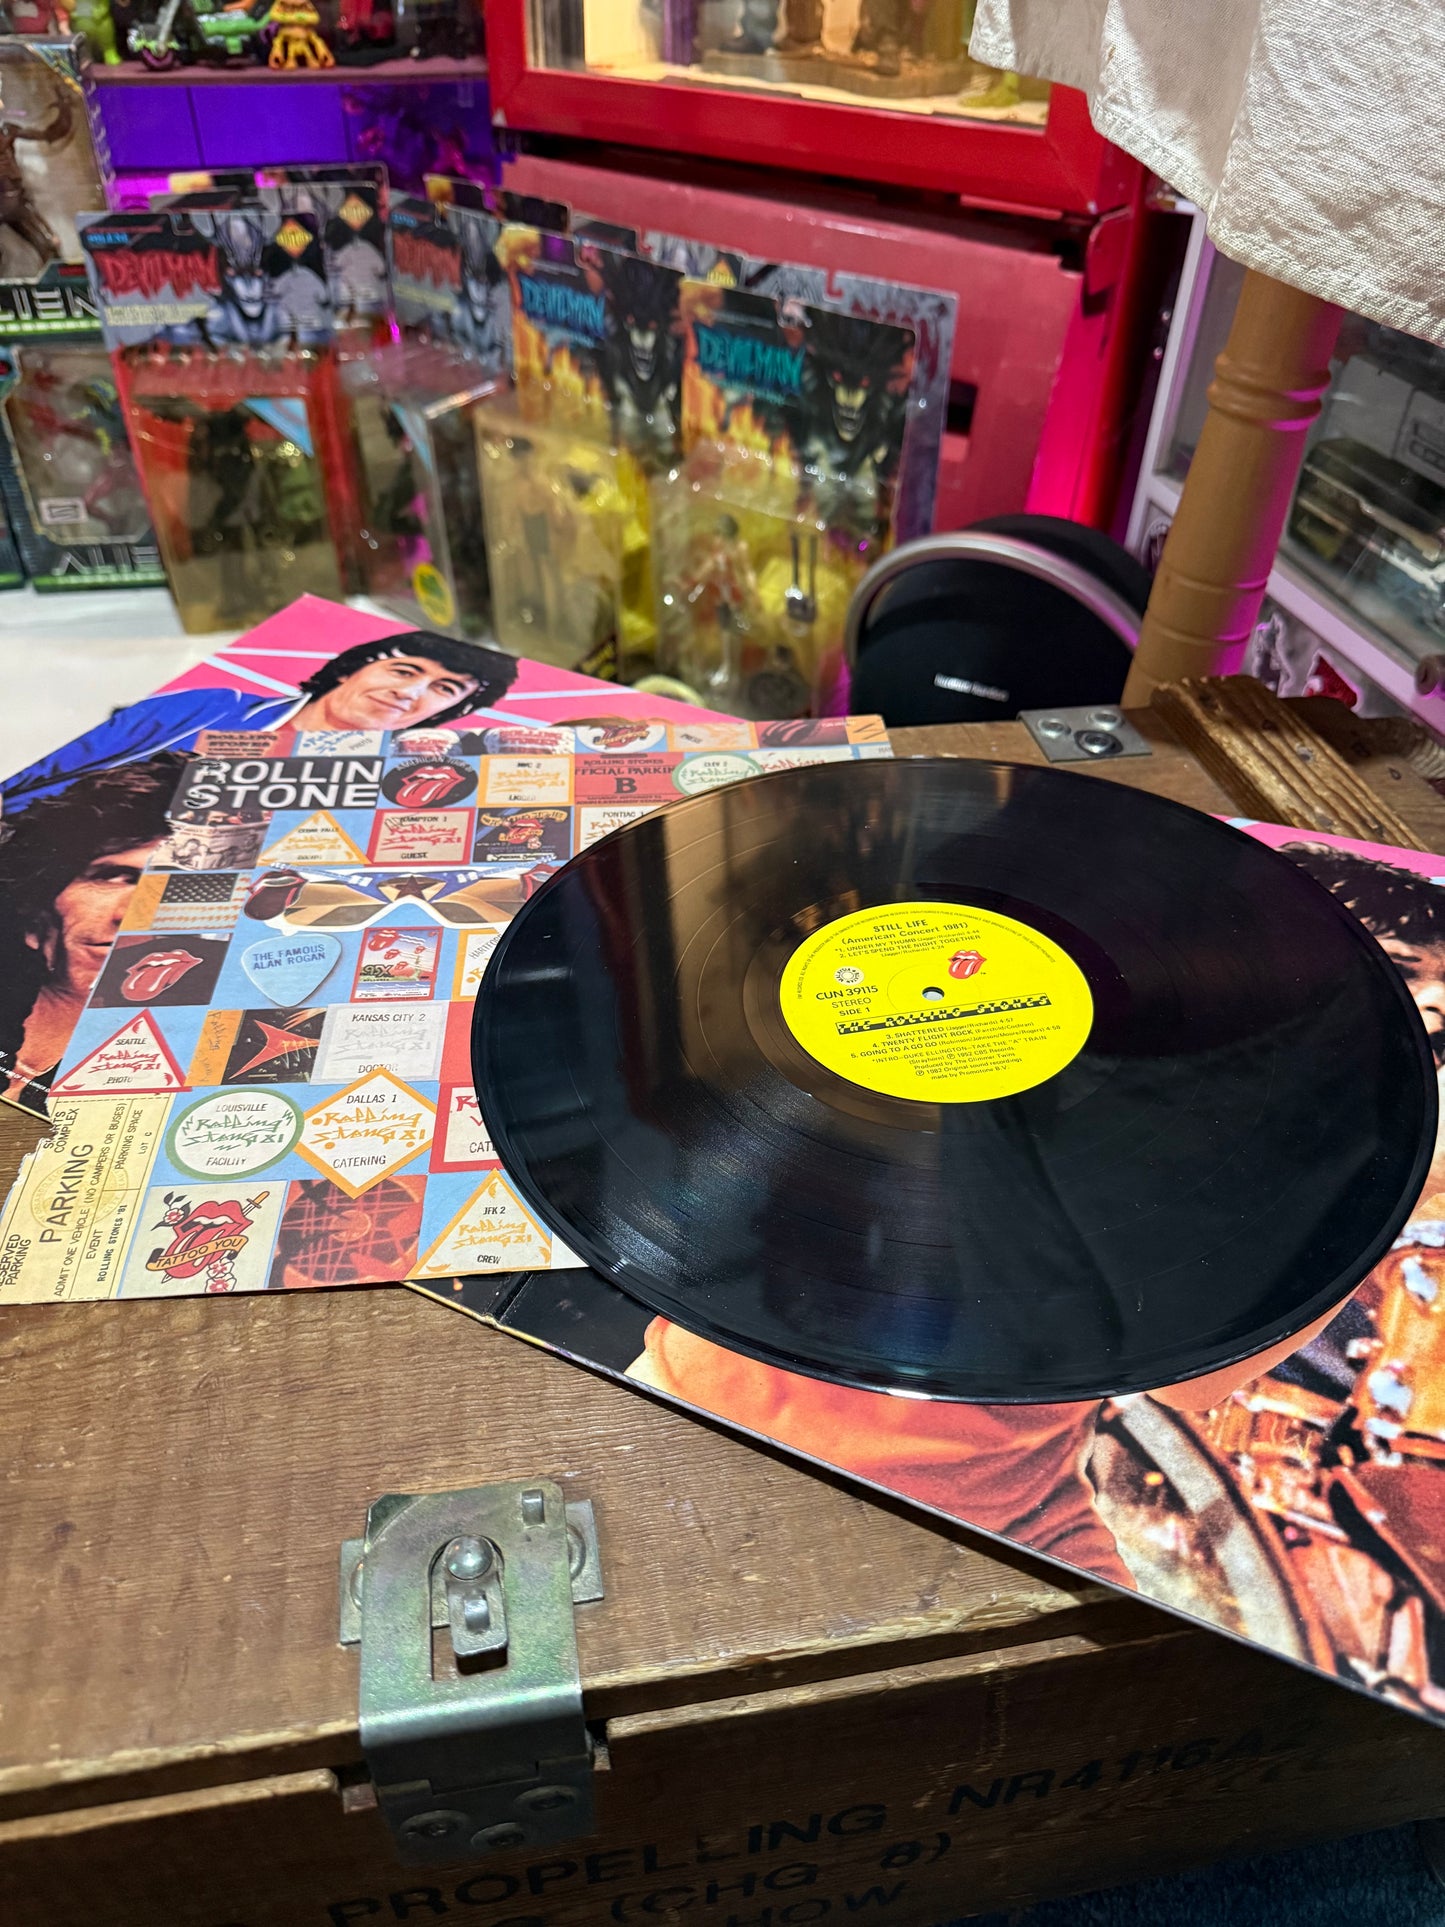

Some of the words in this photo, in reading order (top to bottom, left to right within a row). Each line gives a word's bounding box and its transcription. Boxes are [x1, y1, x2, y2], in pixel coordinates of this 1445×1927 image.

[614, 777, 637, 794] B
[842, 930, 895, 945] (American
[899, 925, 939, 937] Concert
[943, 921, 968, 931] 1981)
[873, 922, 901, 932] STILL
[906, 918, 928, 928] LIFE
[253, 952, 274, 961] THE
[278, 944, 325, 959] FAMOUS
[846, 943, 873, 951] UNDER
[889, 937, 916, 945] THUMB
[847, 949, 869, 957] LET'S
[870, 946, 894, 954] SPEND
[913, 940, 936, 948] NIGHT
[938, 933, 980, 944] TOGETHER
[252, 958, 282, 970] ALAN
[287, 952, 326, 964] ROGAN
[816, 989, 843, 1000] CUN
[845, 984, 878, 996] 39115
[831, 996, 871, 1008] STEREO
[352, 1014, 390, 1022] KANSAS
[393, 1013, 414, 1022] CITY
[419, 1013, 426, 1021] 2
[838, 1007, 862, 1016] SIDE
[838, 1019, 870, 1033] THE
[885, 1006, 960, 1027] ROLLING
[976, 994, 1046, 1014] STONES
[881, 1037, 914, 1047] TWENTY
[917, 1032, 947, 1041] FLIGHT
[950, 1028, 972, 1037] ROCK
[895, 1026, 944, 1038] SHATTERED
[1023, 1034, 1047, 1042] TRAIN
[860, 1048, 887, 1057] GOING
[914, 1061, 942, 1070] Produced
[346, 1095, 385, 1104] DALLAS
[392, 1094, 397, 1102] 1
[216, 1104, 268, 1112] LOUISVILLE
[109, 1103, 127, 1131] BUSES)
[54, 1108, 80, 1153] COMPLEX
[104, 1133, 115, 1145] OR
[115, 1135, 134, 1169] PARKING
[128, 1110, 143, 1133] SPACE
[90, 1147, 110, 1186] CAMPERS
[333, 1155, 386, 1169] CATERING
[39, 1144, 94, 1243] PARKING
[84, 1188, 97, 1204] (NO
[483, 1207, 499, 1216] JFK
[500, 1206, 506, 1214] 2
[70, 1208, 90, 1244] VEHICLE
[86, 1229, 103, 1259] EVENT
[97, 1248, 114, 1282] ROLLING
[108, 1217, 123, 1244] STONES
[63, 1247, 77, 1266] ONE
[155, 1245, 208, 1268] TATTOO
[215, 1238, 243, 1249] YOU
[477, 1255, 501, 1265] CREW
[5, 1239, 31, 1285] PARKING
[54, 1268, 67, 1296] ADMIT
[327, 1804, 886, 1927] PROPELLING
